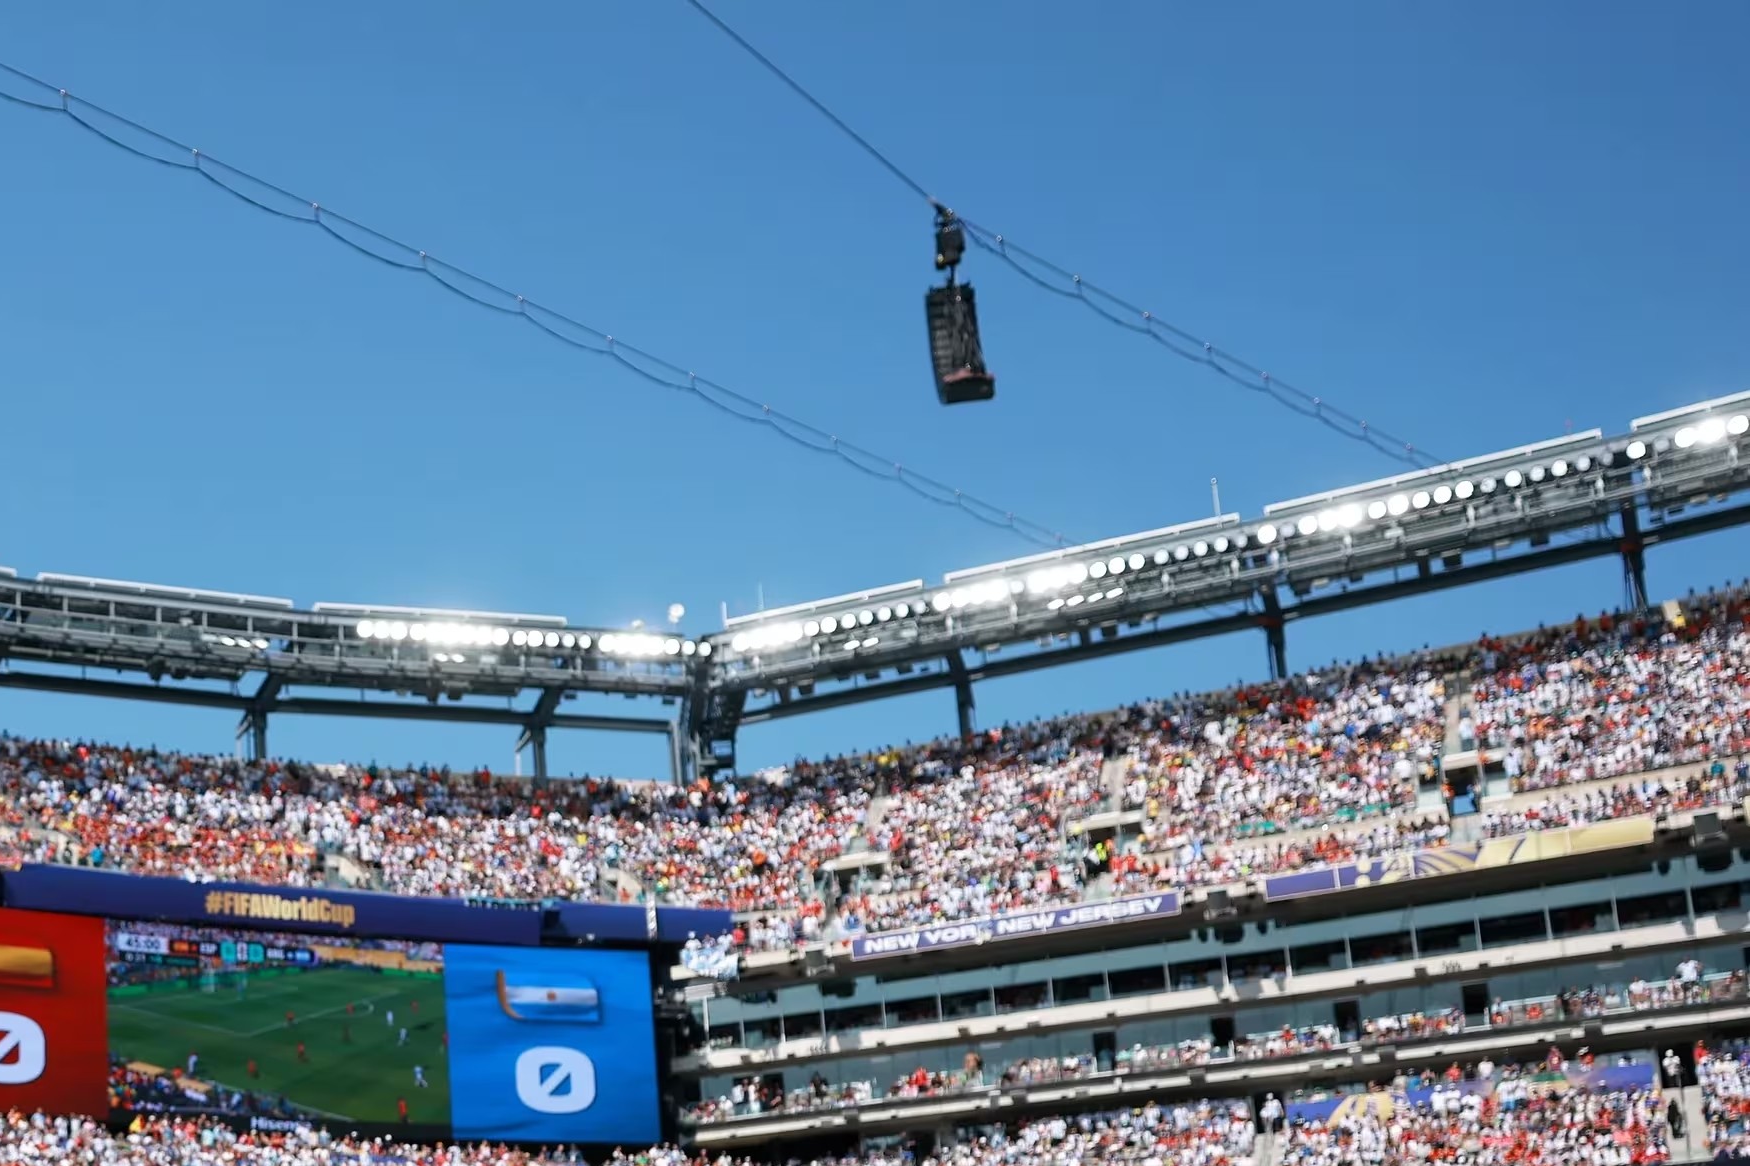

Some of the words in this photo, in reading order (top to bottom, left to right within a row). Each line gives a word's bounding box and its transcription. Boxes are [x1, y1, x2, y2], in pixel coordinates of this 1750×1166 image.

[205, 890, 355, 928] #FIFAWorldCup
[863, 931, 919, 955] NEW
[924, 922, 991, 947] YOR
[996, 910, 1055, 935] NEW
[1059, 896, 1163, 926] JERSEY
[515, 1046, 597, 1114] 0
